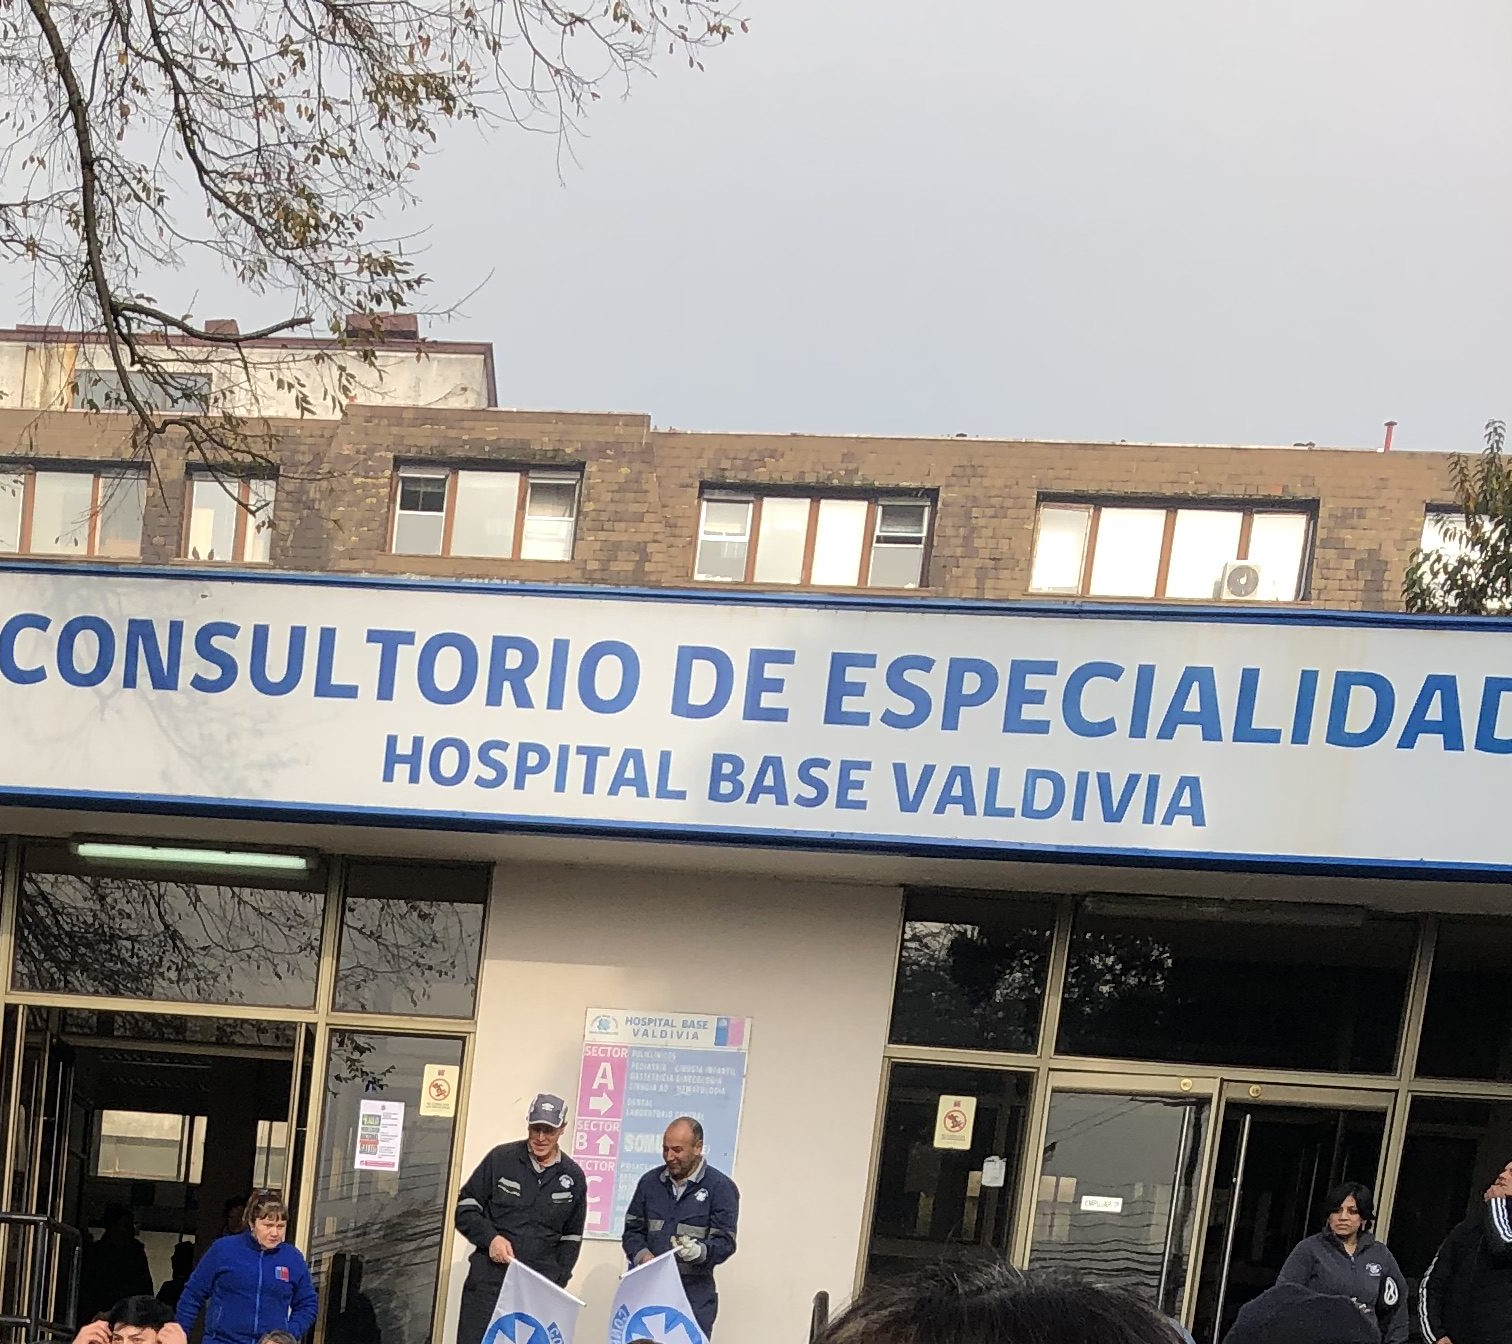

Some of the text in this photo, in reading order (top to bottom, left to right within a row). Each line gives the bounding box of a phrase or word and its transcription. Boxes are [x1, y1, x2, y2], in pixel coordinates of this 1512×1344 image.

[670, 644, 796, 723] DE
[382, 734, 1206, 827] HOSPITAL BASE VALDIVIA
[625, 1016, 676, 1029] HOSPITAL
[681, 1019, 708, 1030] BASE
[632, 1028, 699, 1040] VALDIVIA
[584, 1046, 629, 1058] SECTOR
[592, 1062, 615, 1091] A
[577, 1120, 620, 1132] SECTOR
[575, 1132, 588, 1150] B
